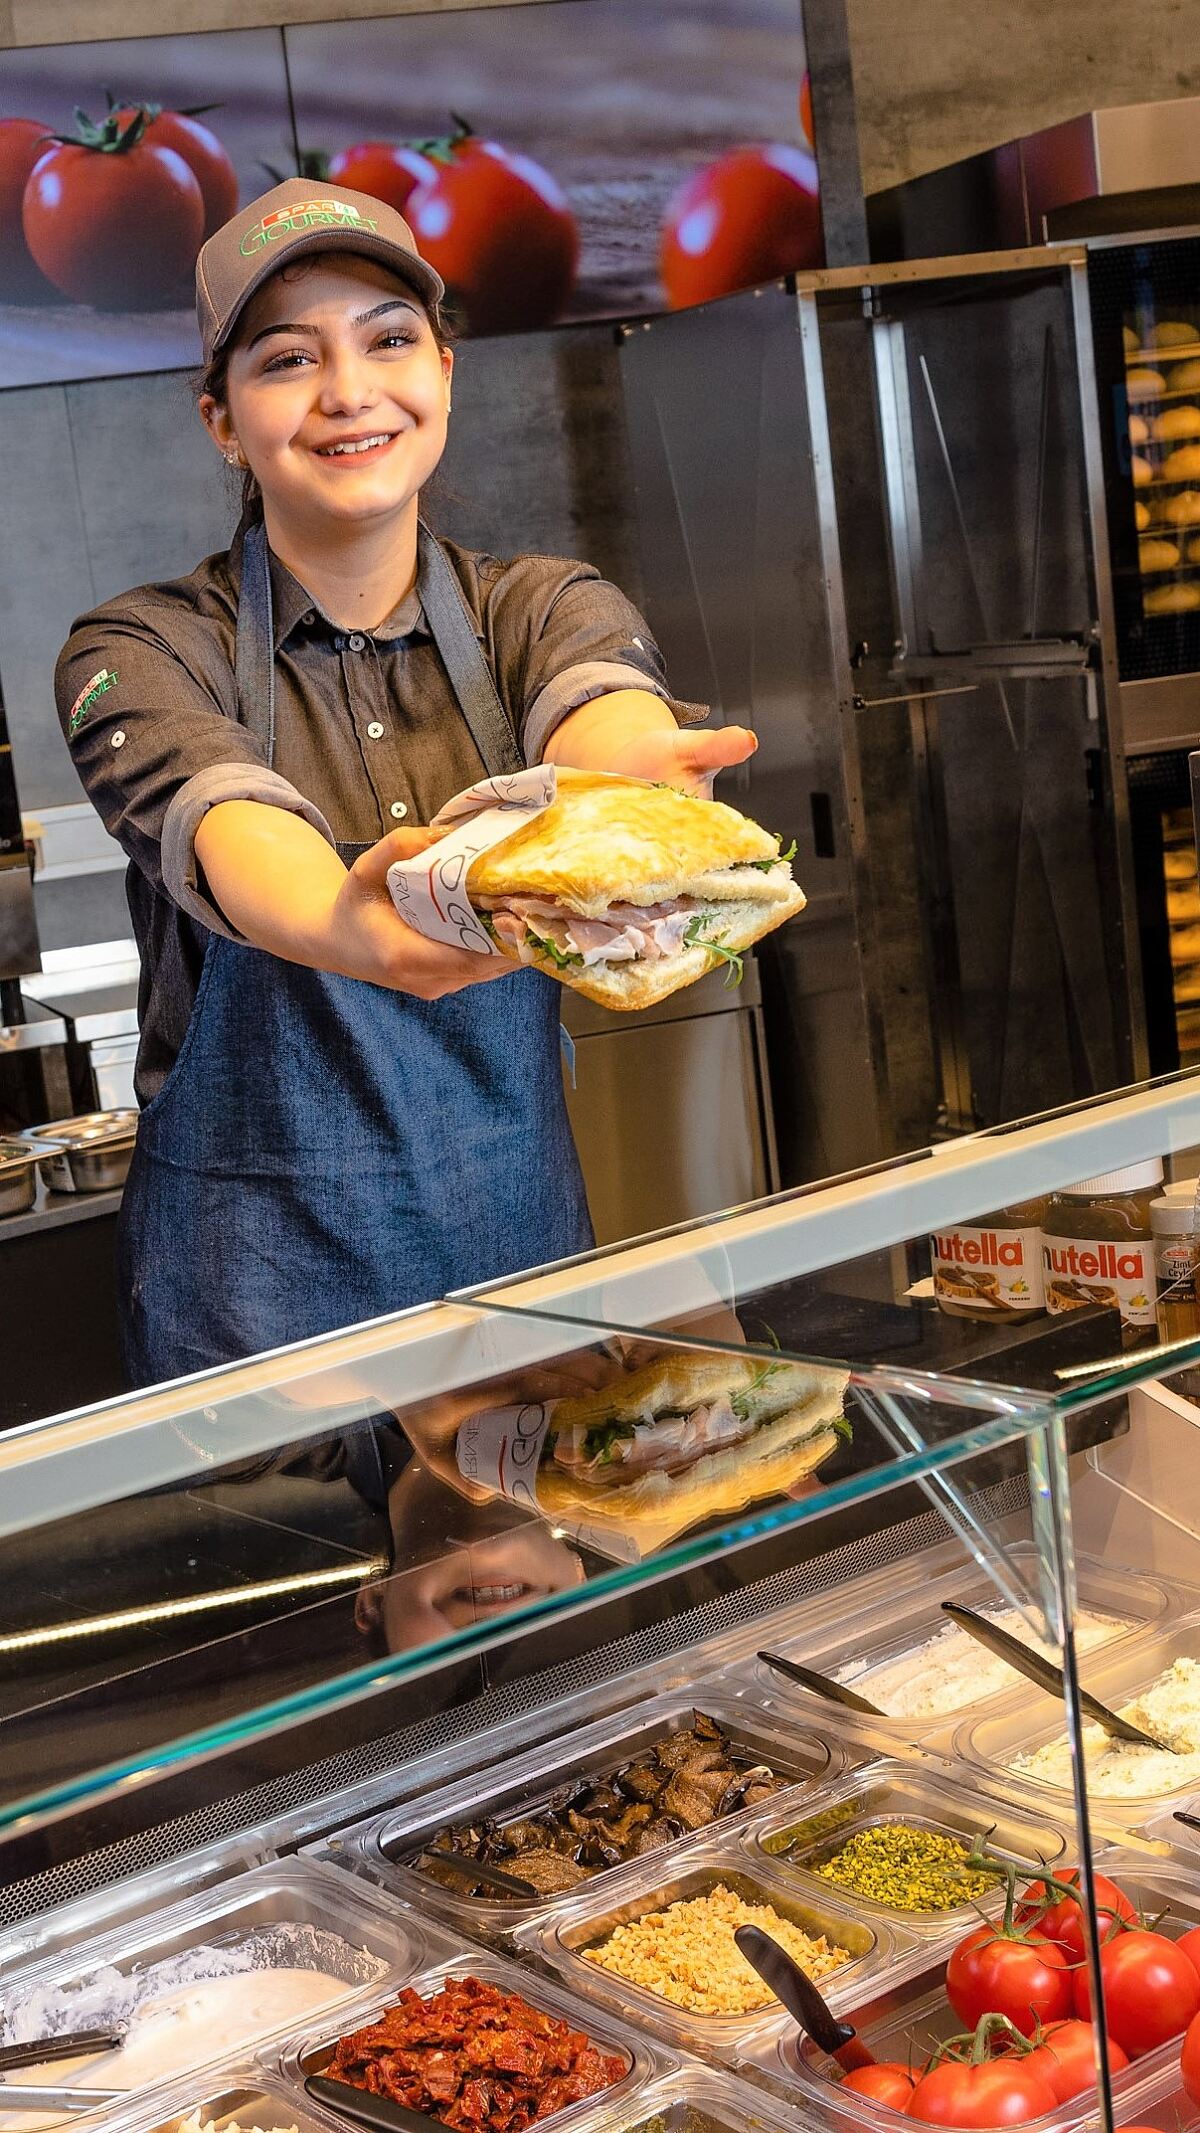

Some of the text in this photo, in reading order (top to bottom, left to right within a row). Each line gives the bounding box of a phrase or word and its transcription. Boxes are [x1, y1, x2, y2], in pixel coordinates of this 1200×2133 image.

[277, 202, 335, 219] SPAR
[240, 213, 378, 256] GOURMET
[446, 902, 493, 956] GO
[930, 1232, 1023, 1267] nutella
[1041, 1244, 1144, 1280] nutella
